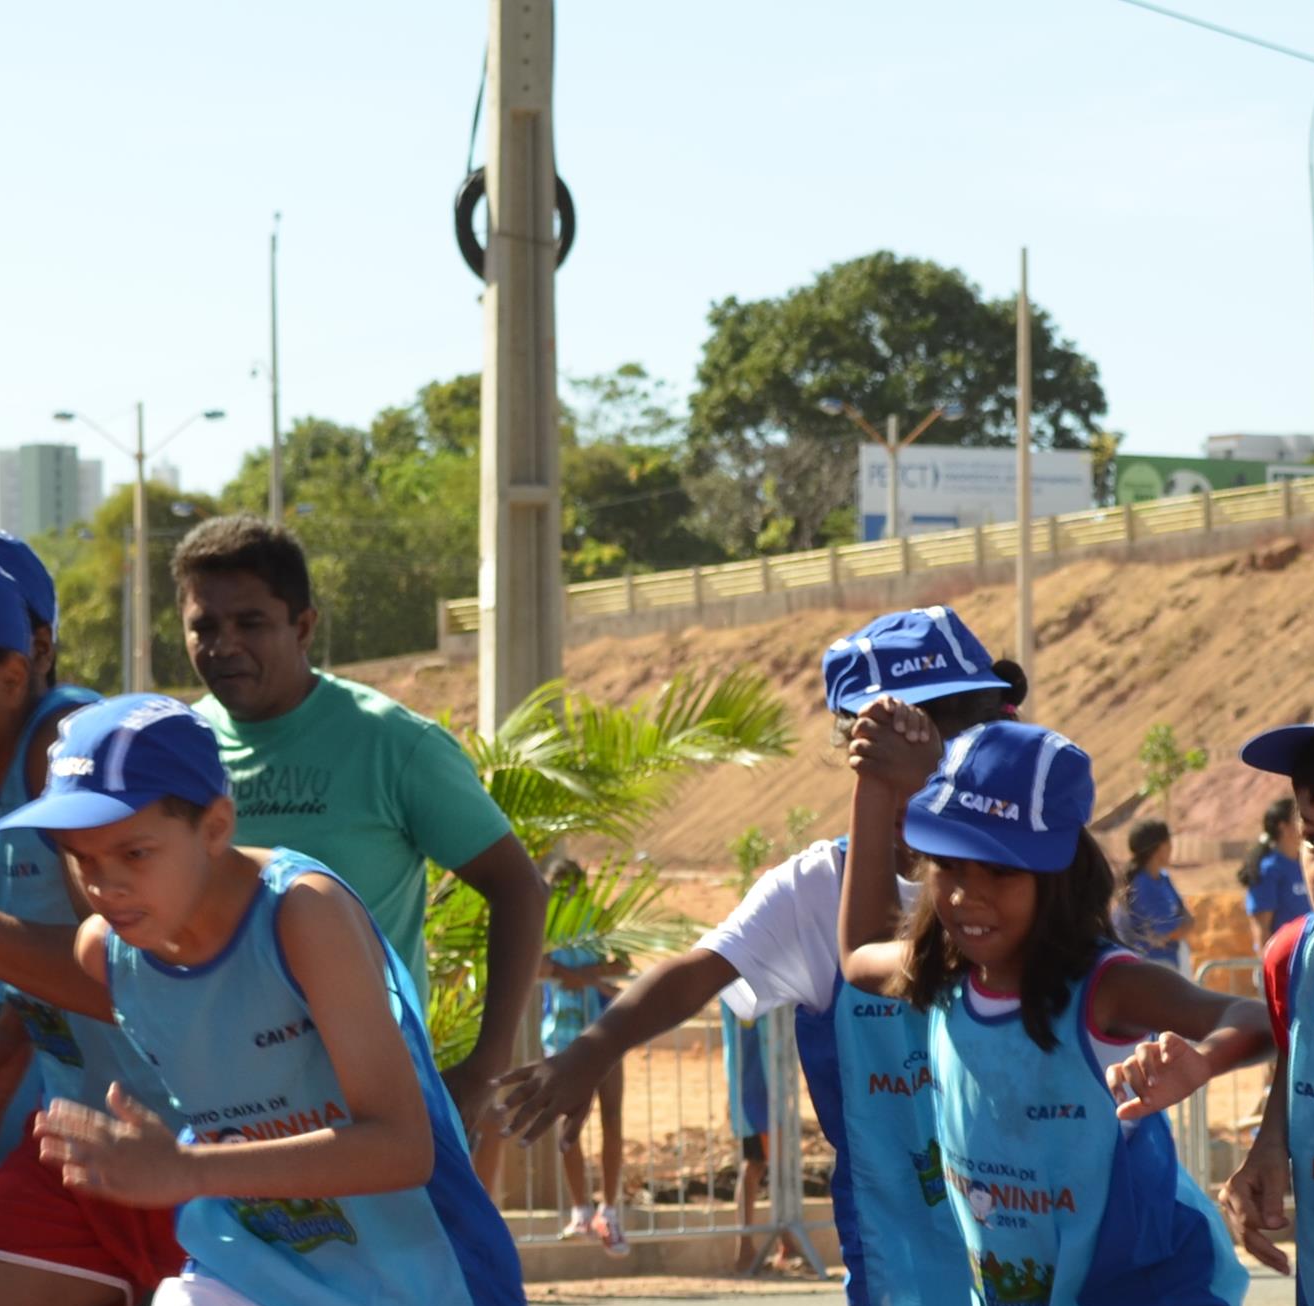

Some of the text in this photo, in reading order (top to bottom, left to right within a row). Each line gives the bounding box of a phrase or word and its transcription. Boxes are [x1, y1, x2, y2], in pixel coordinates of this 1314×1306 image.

[890, 653, 948, 678] CAIXA
[958, 791, 1020, 822] CAIXA
[254, 1017, 315, 1048] CAIXA
[223, 1102, 266, 1119] CAIXA
[269, 1095, 289, 1110] DE
[1026, 1103, 1087, 1120] CAIXA
